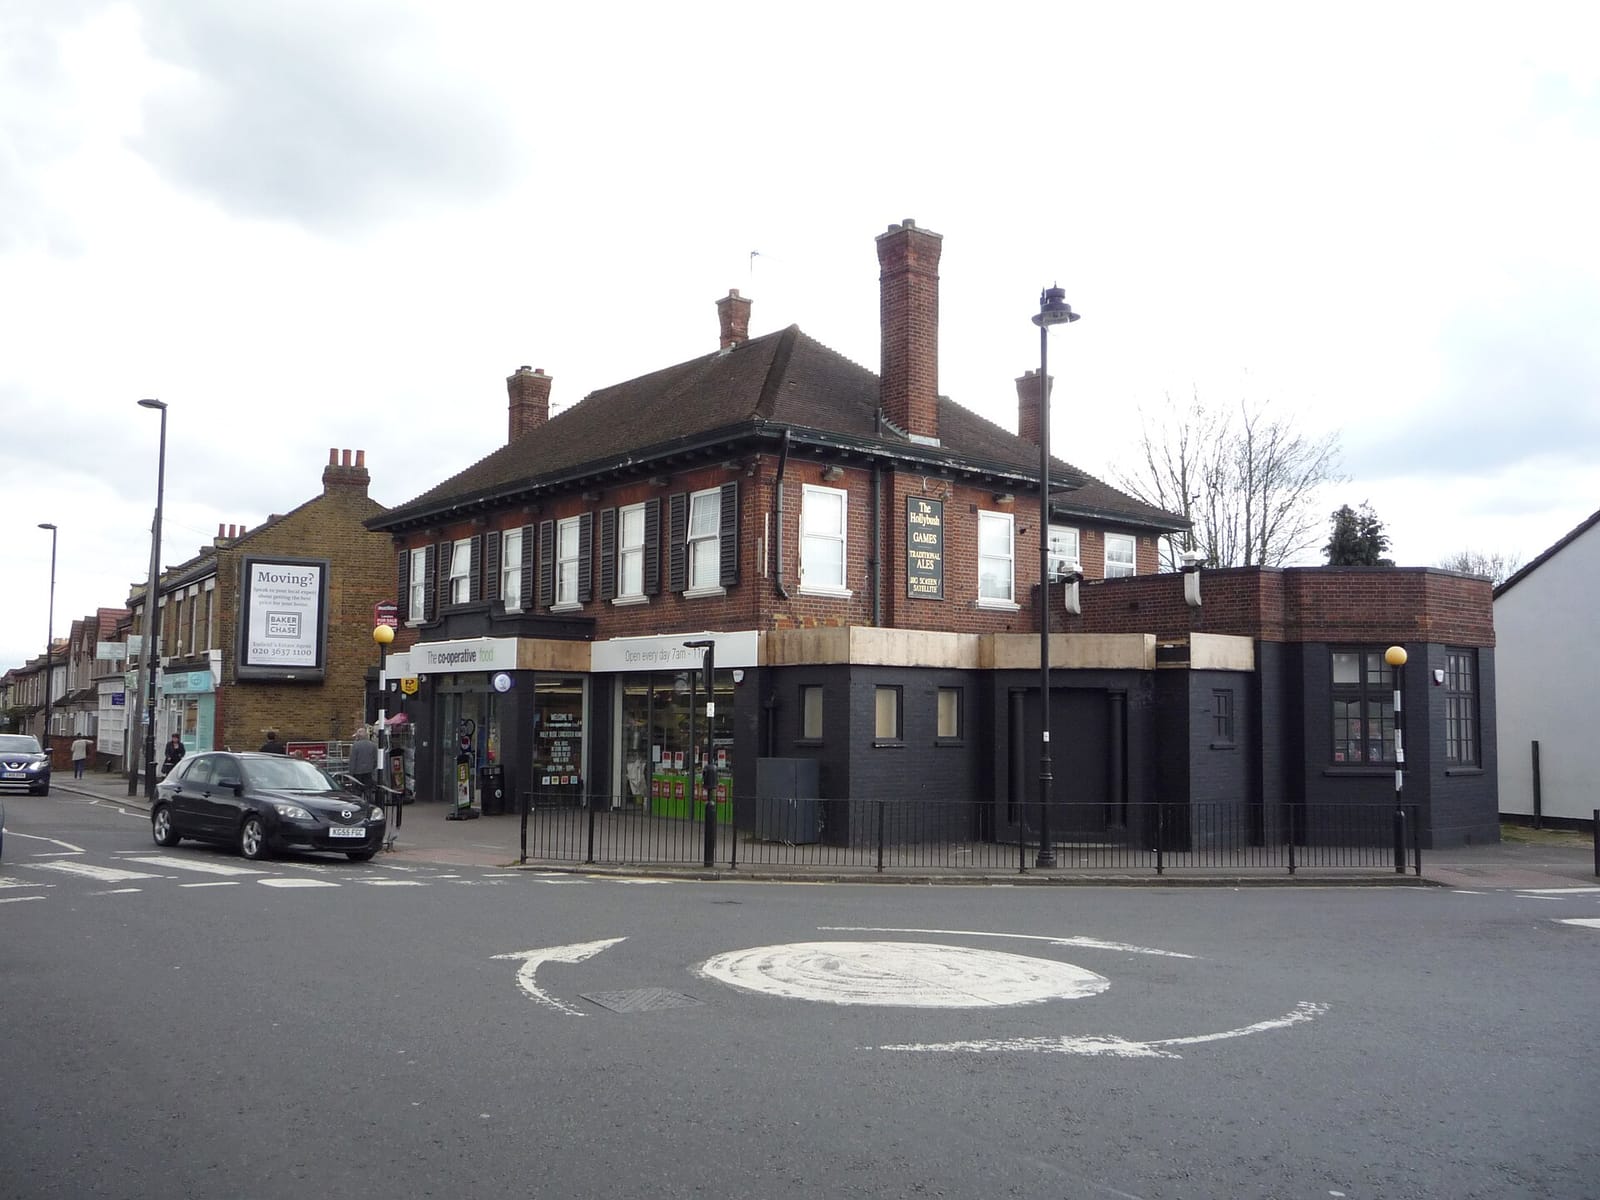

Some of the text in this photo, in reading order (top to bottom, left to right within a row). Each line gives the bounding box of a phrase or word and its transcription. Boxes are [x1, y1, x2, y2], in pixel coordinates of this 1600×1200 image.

[918, 502, 932, 513] The
[910, 512, 940, 526] Hollybush
[913, 532, 937, 544] GAMES
[909, 551, 941, 561] TRADITIONAL
[916, 559, 935, 570] ALES
[258, 571, 315, 587] Moving?
[270, 626, 297, 634] CHASE
[271, 648, 291, 656] 3637
[428, 647, 494, 666] The co-operative food
[625, 650, 641, 662] Open
[642, 650, 657, 664] every
[659, 648, 670, 664] day
[672, 647, 686, 660] 7am
